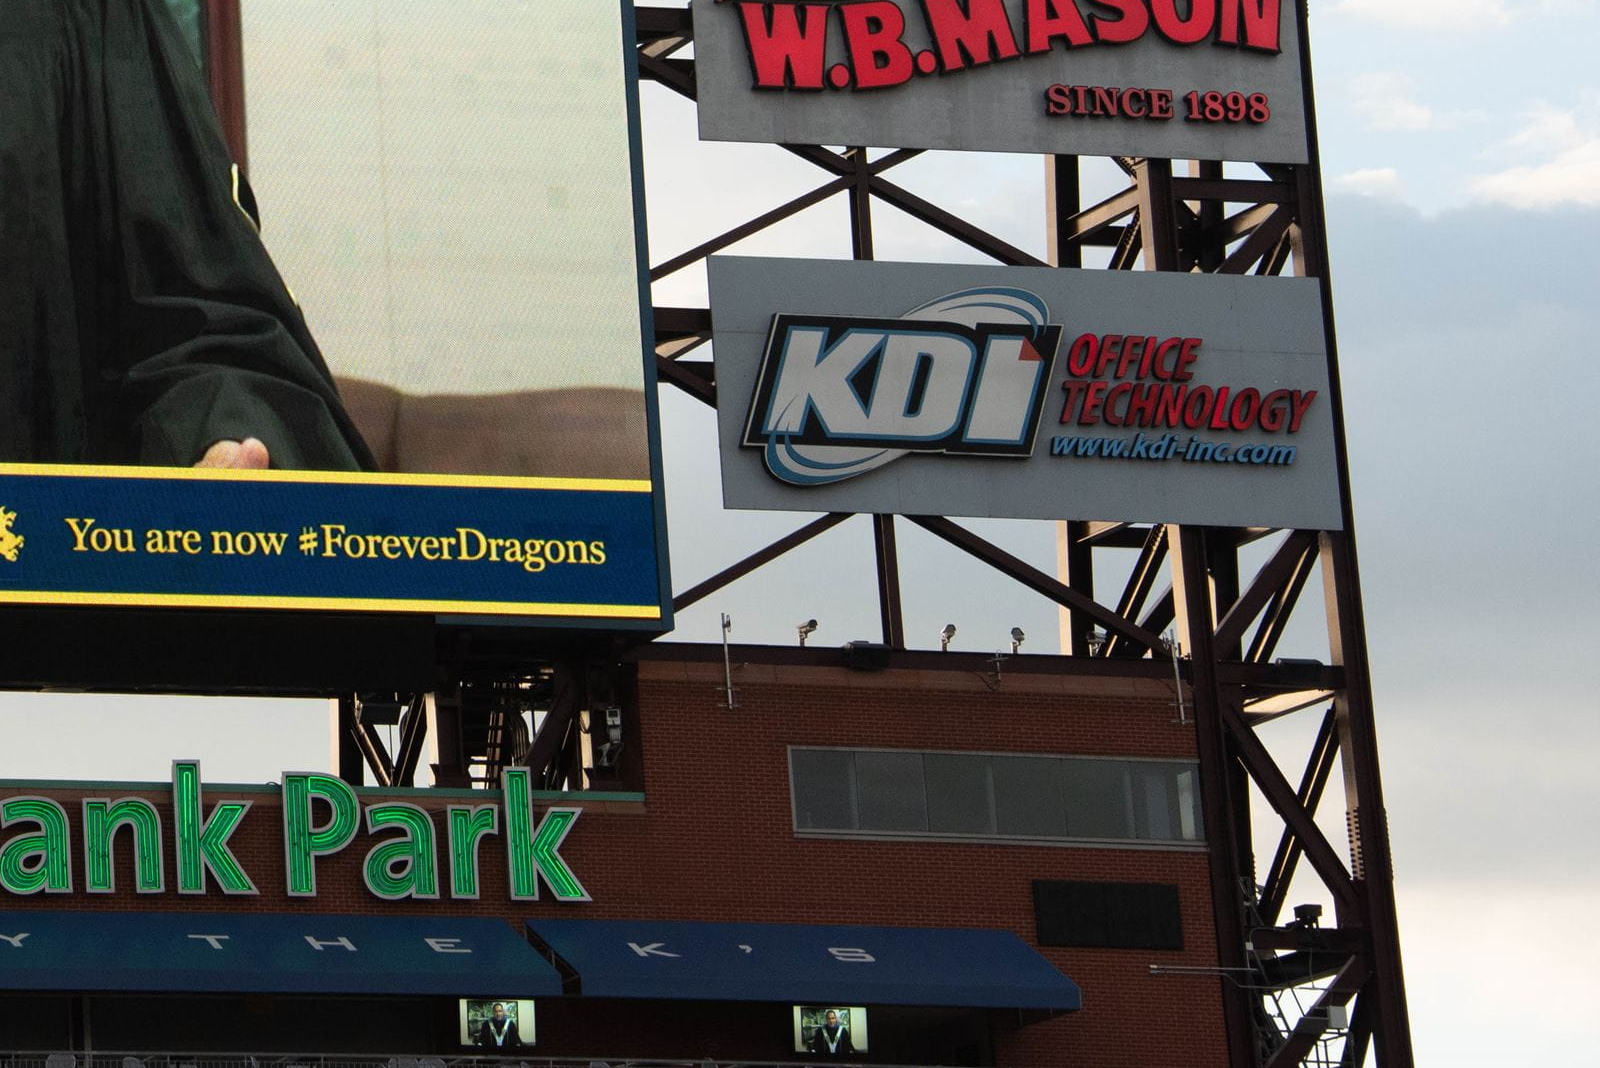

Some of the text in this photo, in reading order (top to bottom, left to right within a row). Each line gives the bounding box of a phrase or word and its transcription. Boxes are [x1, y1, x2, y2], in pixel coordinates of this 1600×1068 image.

[1045, 84, 1270, 123] SINCE 1898
[1067, 333, 1203, 381] OFFICE
[1059, 380, 1318, 432] TECHNOLOGY
[1051, 432, 1297, 465] www.kdi-inc.com
[65, 518, 607, 572] You are now #ForeverDragons
[281, 766, 593, 902] Park
[187, 933, 473, 954] THE
